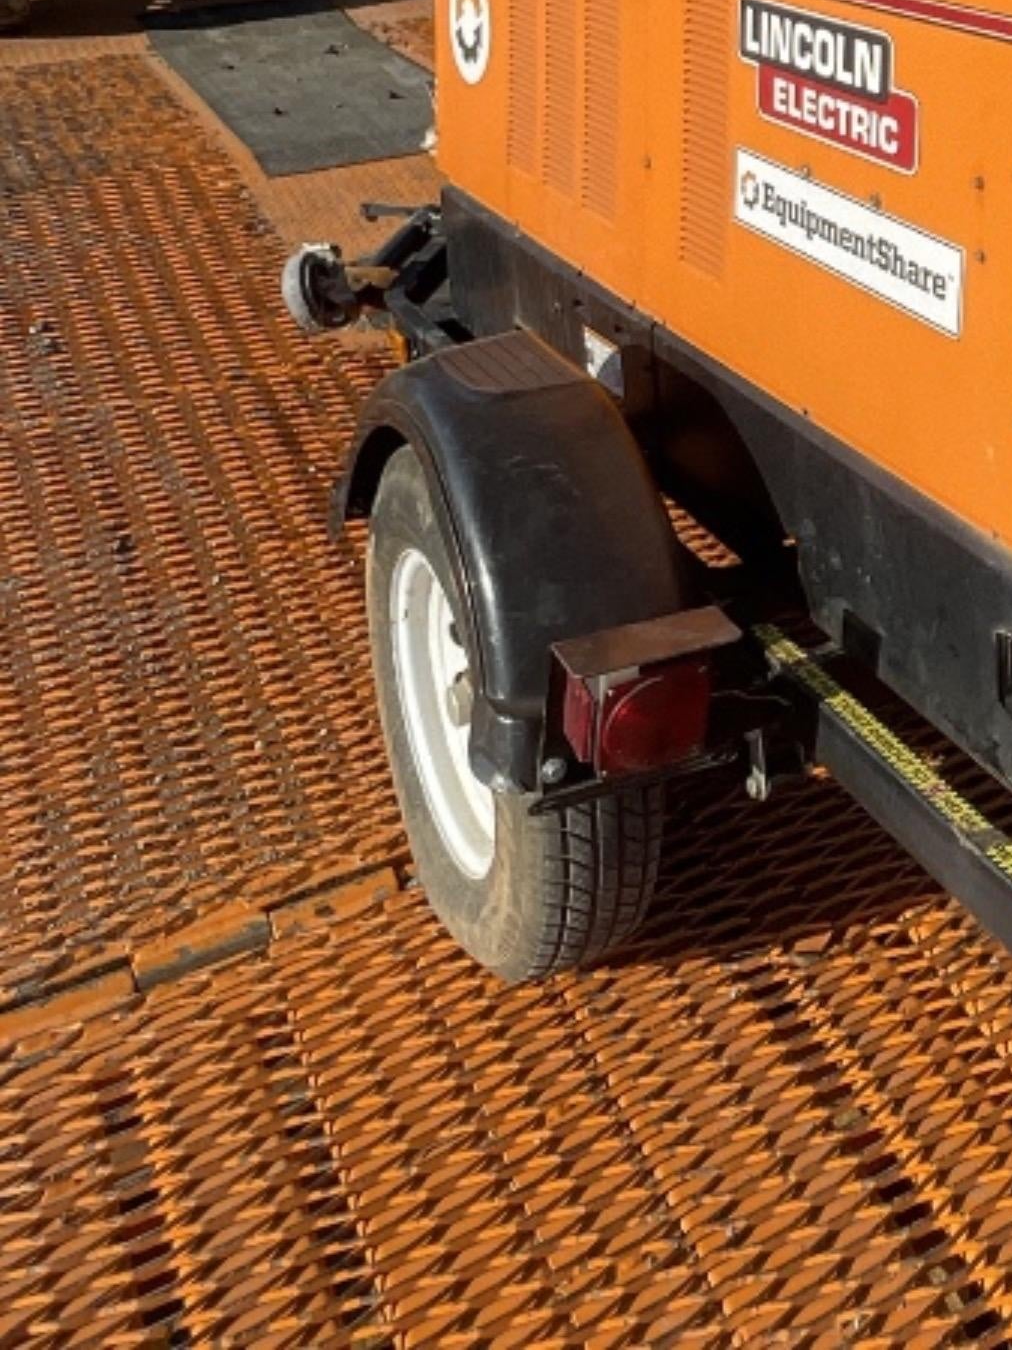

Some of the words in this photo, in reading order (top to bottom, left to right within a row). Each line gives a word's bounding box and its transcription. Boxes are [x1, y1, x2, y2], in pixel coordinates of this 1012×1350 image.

[745, 5, 883, 96] LINCOLN
[772, 77, 899, 154] ELECTRIC
[761, 181, 947, 301] EquipmentShare
